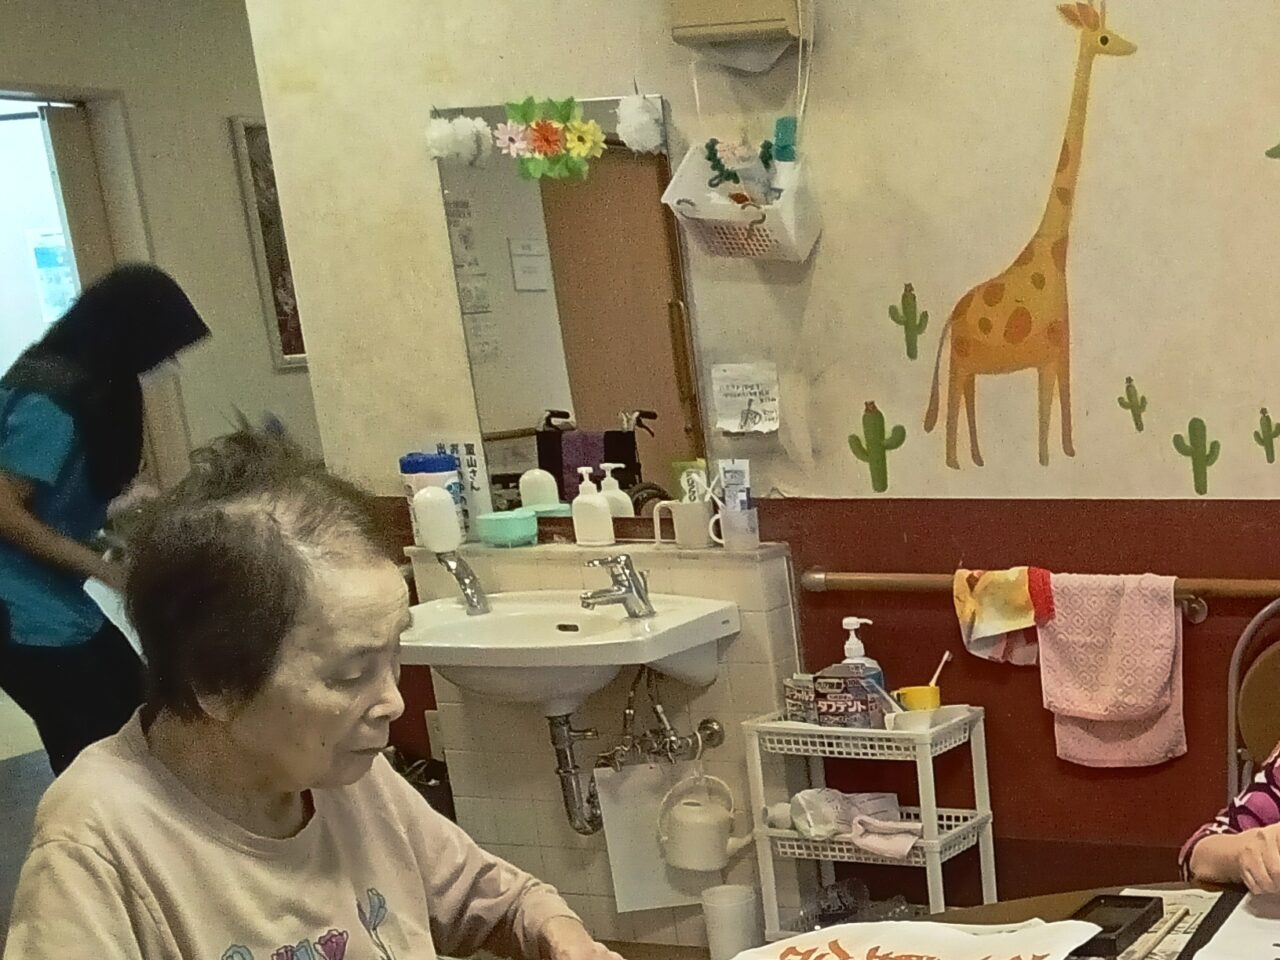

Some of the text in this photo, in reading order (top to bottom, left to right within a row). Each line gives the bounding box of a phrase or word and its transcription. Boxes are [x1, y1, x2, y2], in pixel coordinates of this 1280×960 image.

[817, 700, 867, 713] タフデント
